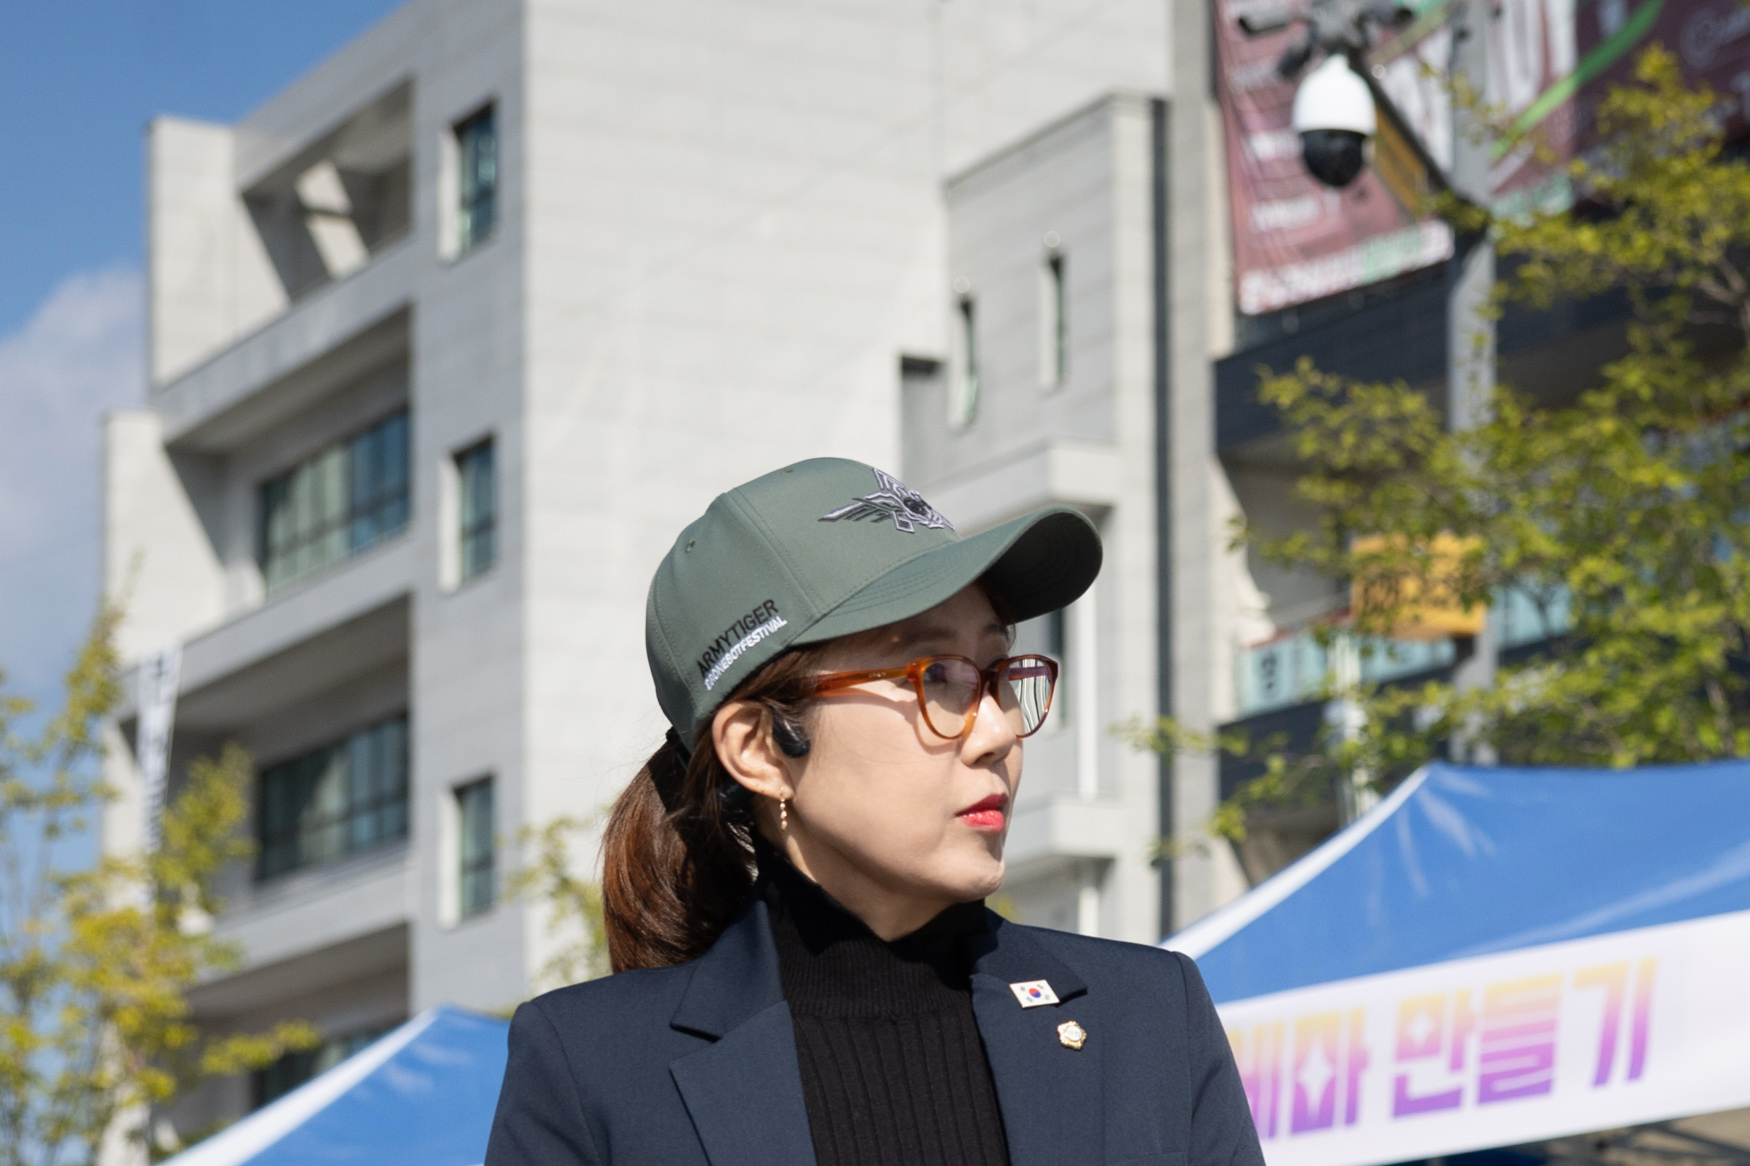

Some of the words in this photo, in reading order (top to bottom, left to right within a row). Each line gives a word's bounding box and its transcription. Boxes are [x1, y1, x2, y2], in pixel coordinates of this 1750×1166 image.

[697, 599, 779, 678] ARMYTIGER
[704, 615, 788, 691] DRONEBOTFESTIVAL
[1391, 956, 1659, 1118] 만들기
